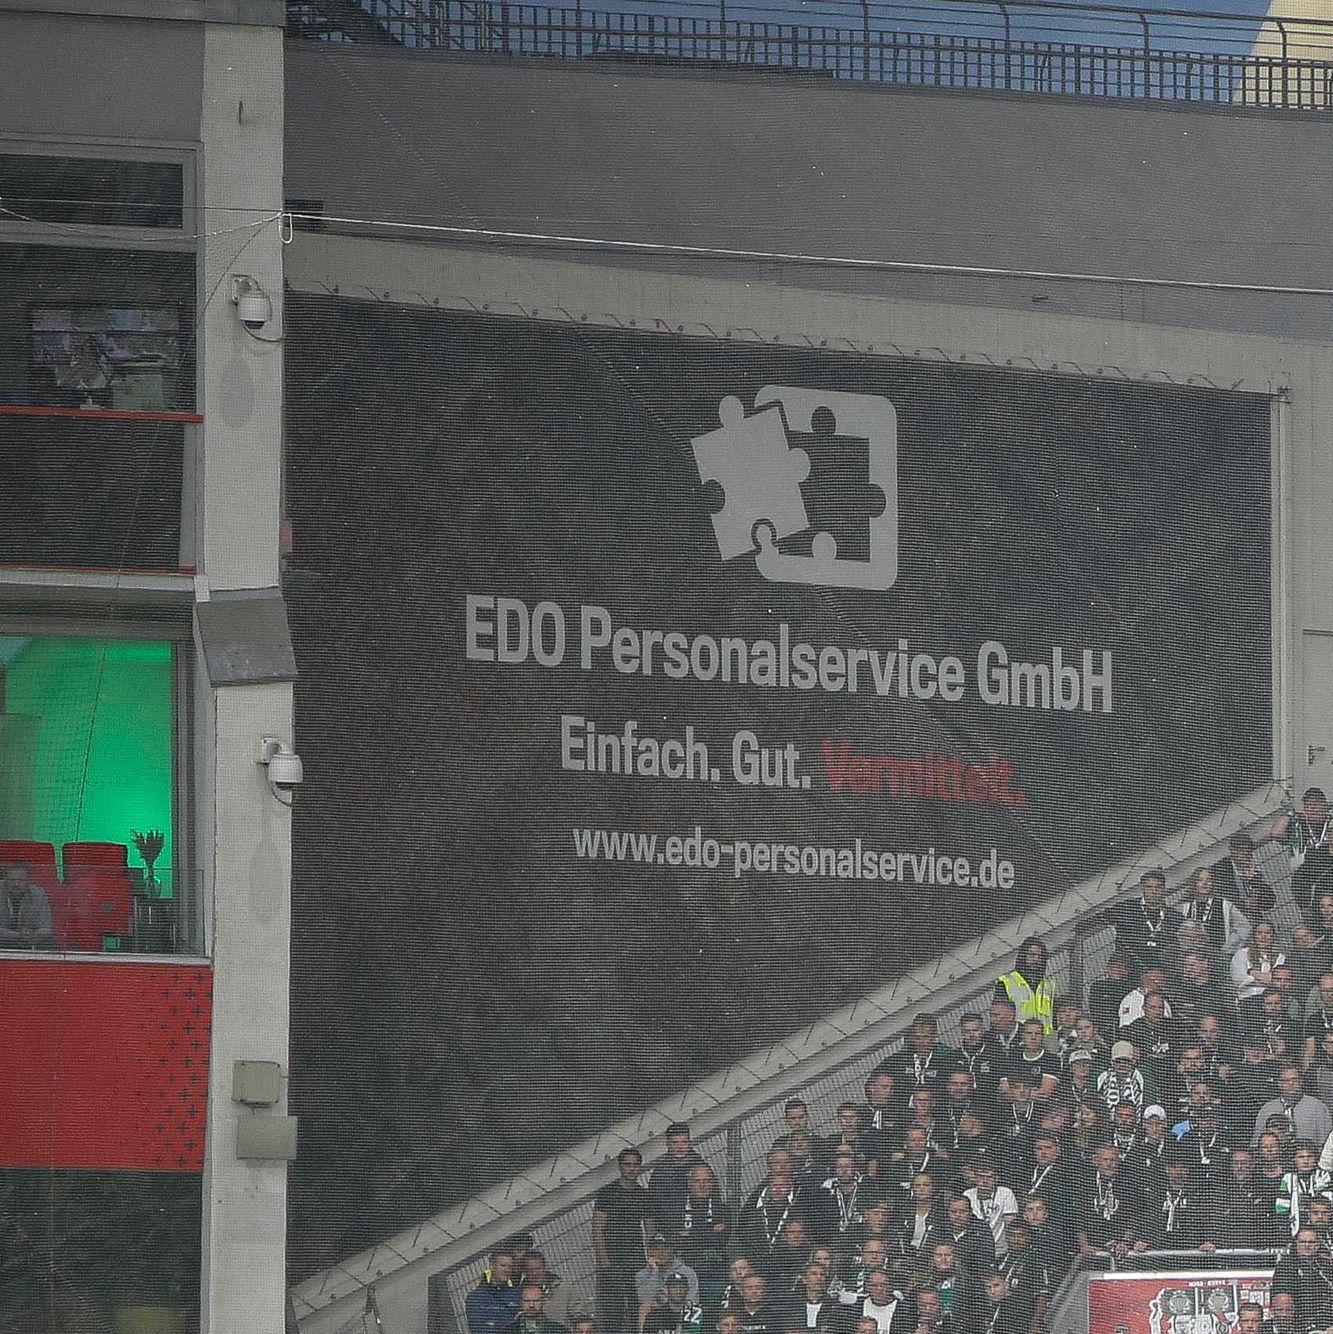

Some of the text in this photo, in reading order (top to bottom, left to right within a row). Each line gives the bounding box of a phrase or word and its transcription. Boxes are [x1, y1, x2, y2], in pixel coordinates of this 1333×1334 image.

[465, 593, 1113, 713] EDO Personalservice GmbH
[560, 714, 720, 781] Einfach.
[731, 730, 811, 790] Gut.
[573, 826, 1016, 890] www.edo-personalservice.de
